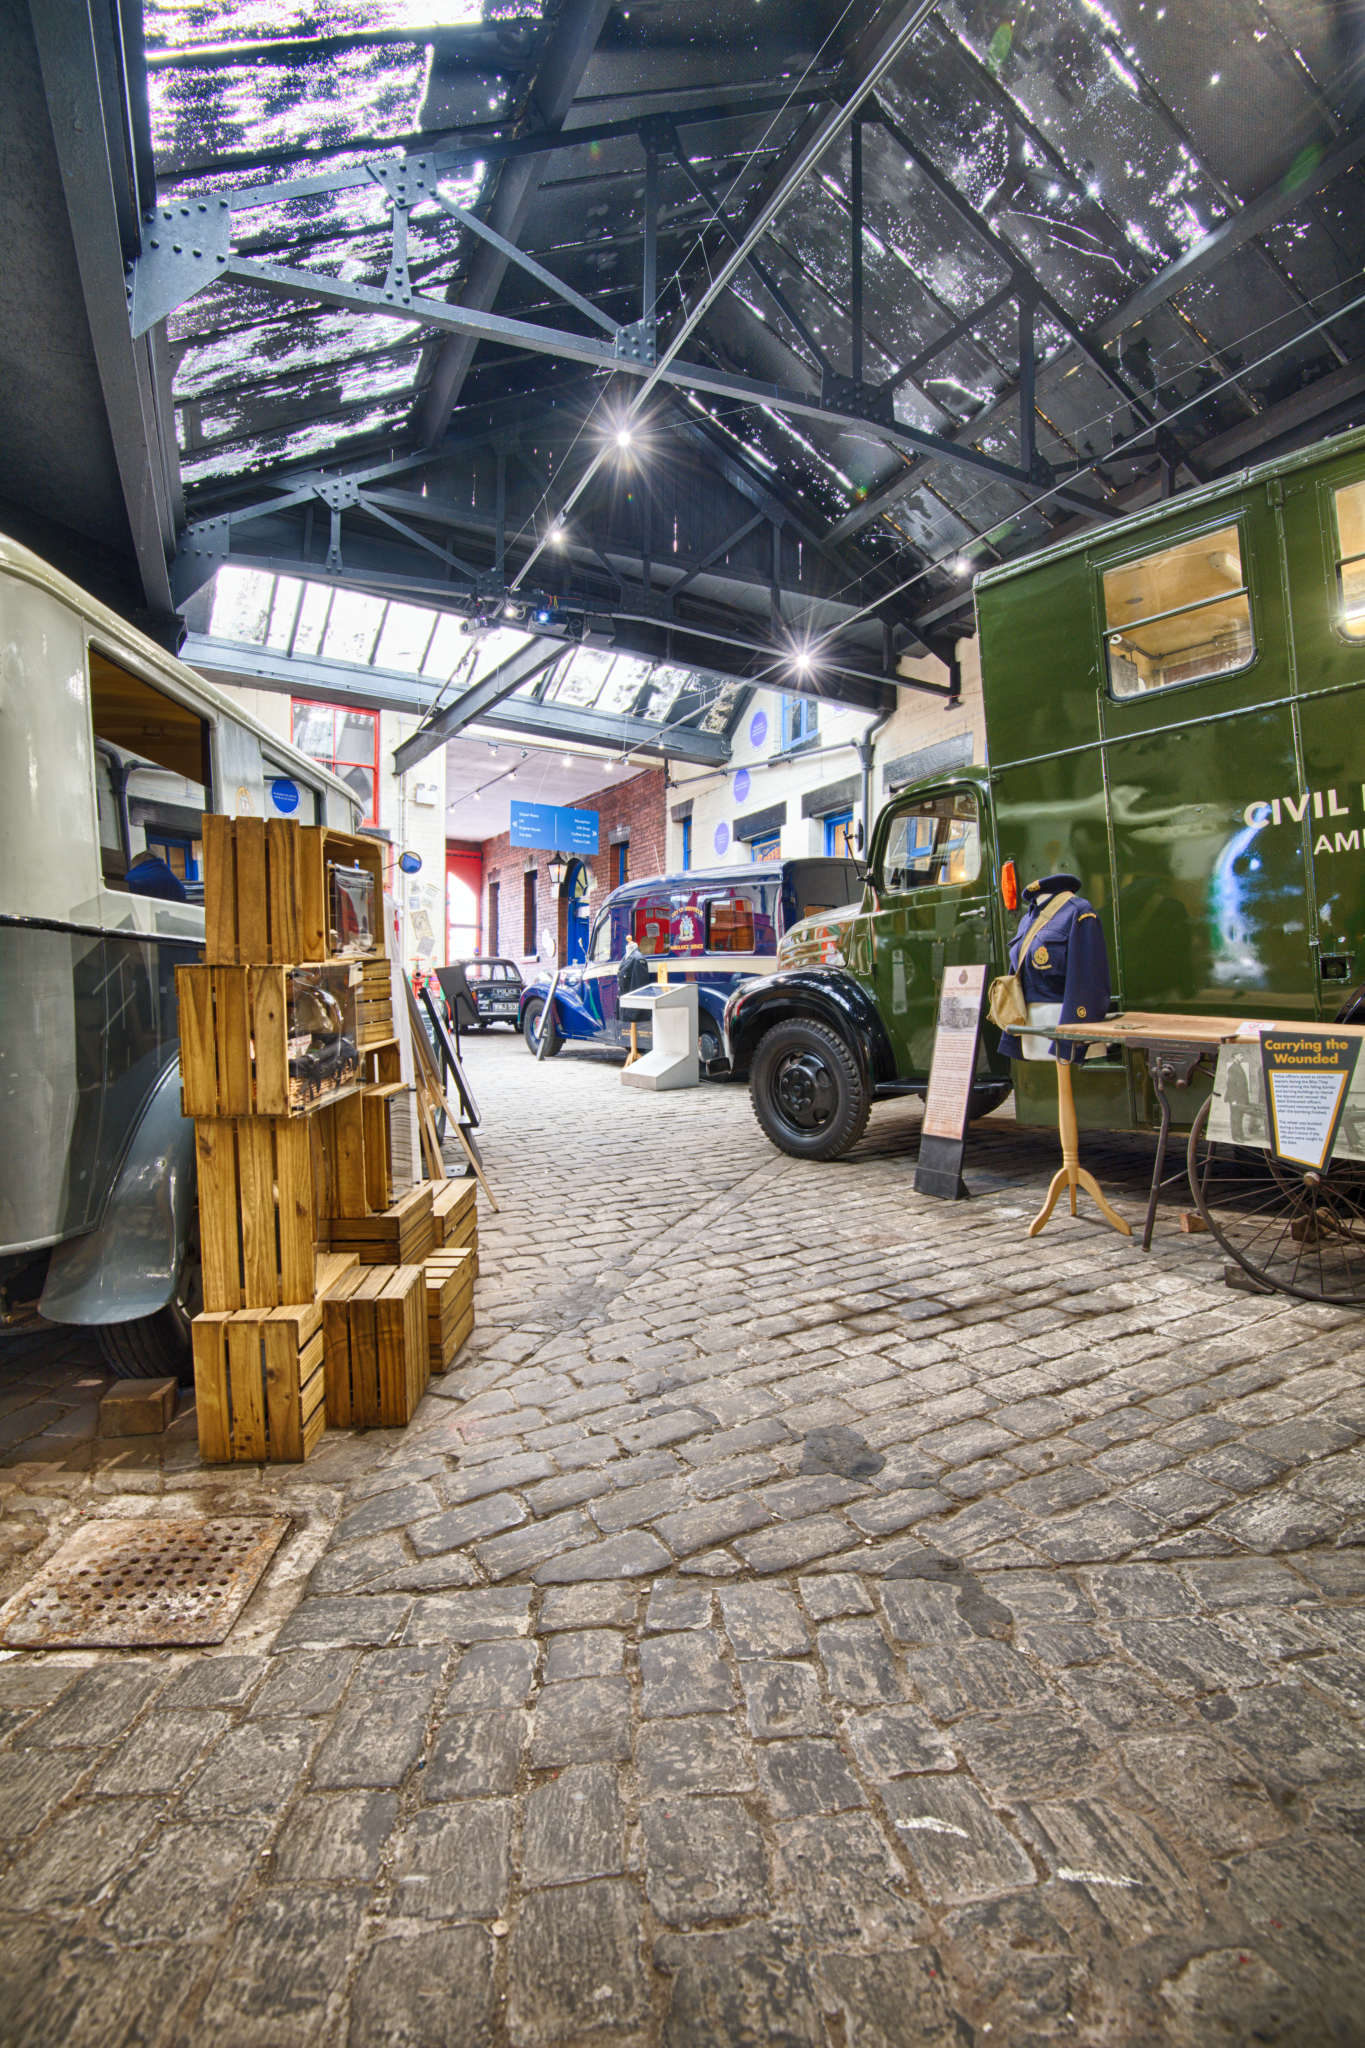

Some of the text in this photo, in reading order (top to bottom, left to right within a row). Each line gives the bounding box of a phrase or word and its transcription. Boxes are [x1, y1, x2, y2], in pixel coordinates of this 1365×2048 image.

[1244, 788, 1349, 829] CIVIL
[1314, 829, 1365, 856] AM
[1264, 1038, 1348, 1052] Carrying the
[1274, 1052, 1339, 1064] Wounded
